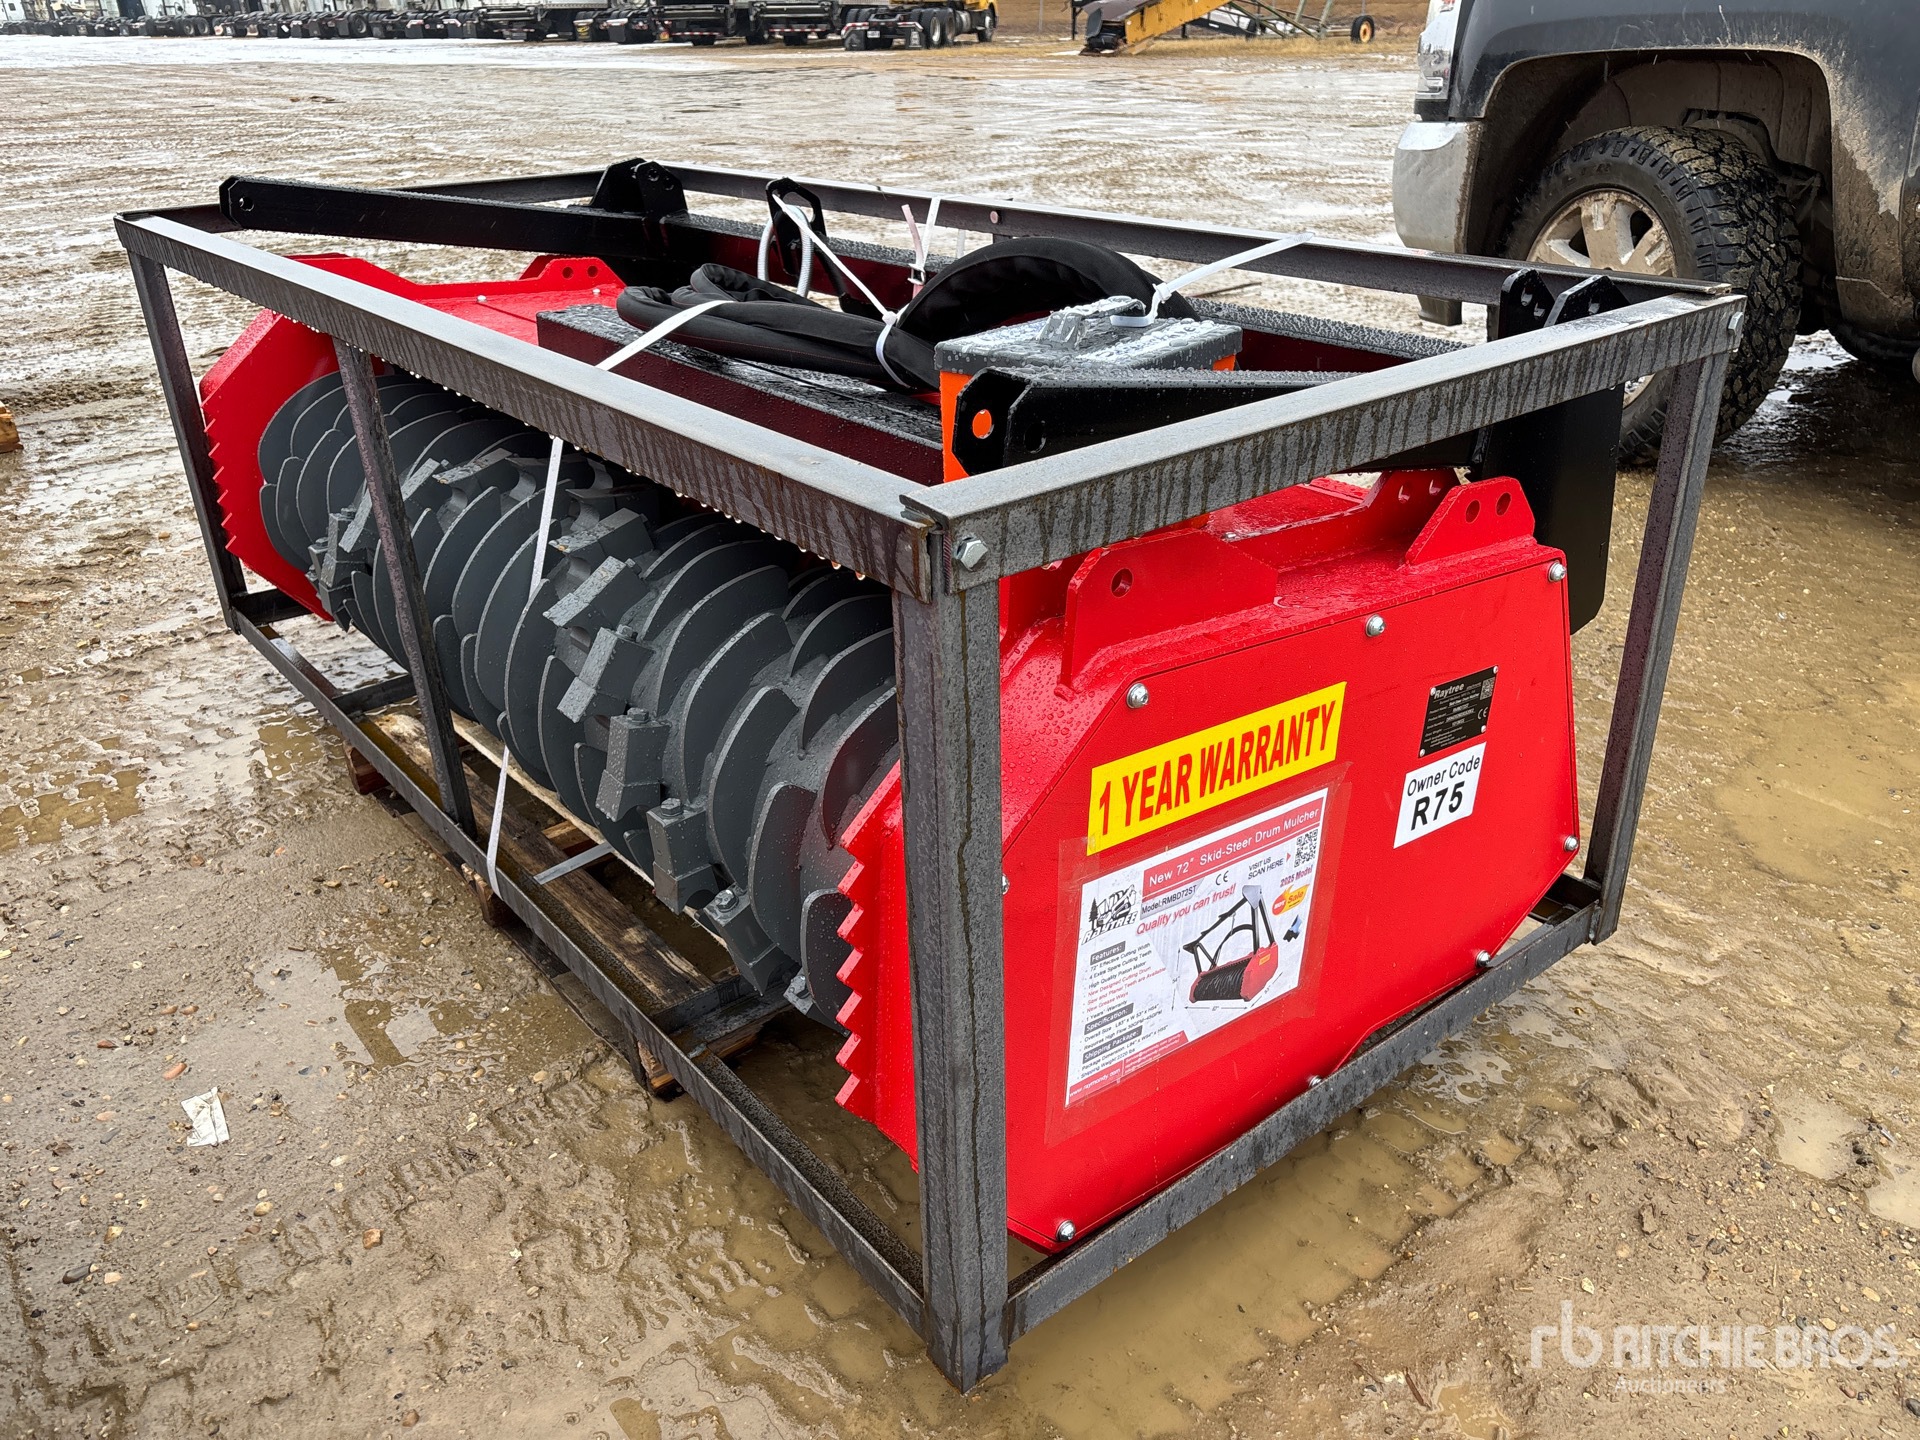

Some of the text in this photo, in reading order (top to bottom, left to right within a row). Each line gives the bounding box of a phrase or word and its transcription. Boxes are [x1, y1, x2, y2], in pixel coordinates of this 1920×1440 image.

[1433, 683, 1465, 699] Raytree
[1100, 700, 1336, 836] 1 YEAR WARRANTY
[1407, 755, 1481, 797] Owner Code
[1410, 780, 1466, 831] R75
[1150, 809, 1319, 887] New 72" Skid-Steer Drum Mulcher
[1248, 858, 1283, 880] SCAN HERE
[1249, 857, 1271, 871] VISIT US
[1295, 864, 1313, 880] Model
[1136, 883, 1236, 935] Quality you can trust!
[1287, 891, 1304, 904] Sale
[1092, 946, 1122, 962] Features:
[1085, 1044, 1111, 1061] Shipping
[1112, 1031, 1139, 1047] Package:
